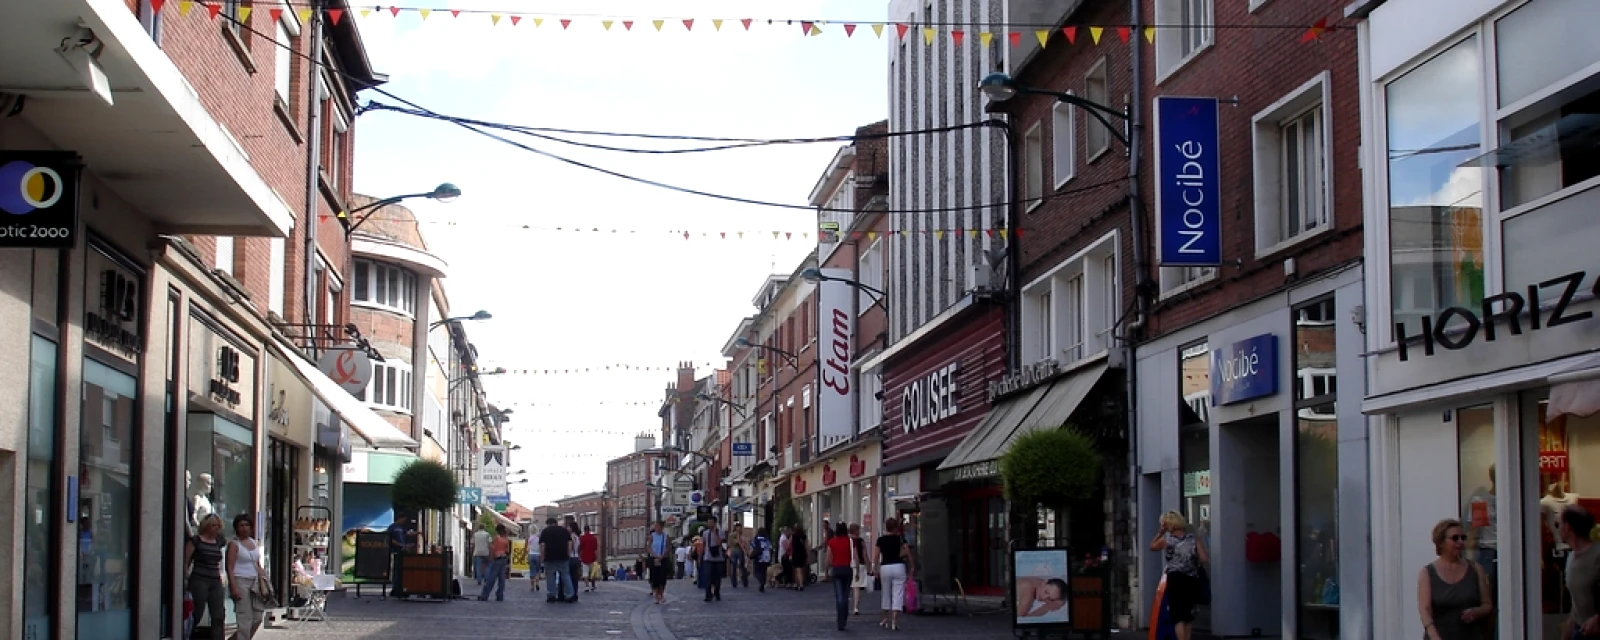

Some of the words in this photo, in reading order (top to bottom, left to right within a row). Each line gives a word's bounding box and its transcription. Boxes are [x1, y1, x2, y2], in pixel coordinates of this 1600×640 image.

[30, 224, 69, 238] 2000
[1175, 140, 1205, 254] Nocibé
[823, 308, 849, 396] Etam
[1396, 270, 1600, 361] HORIZ
[902, 361, 957, 435] COLISEE
[1219, 345, 1259, 382] Nocibé
